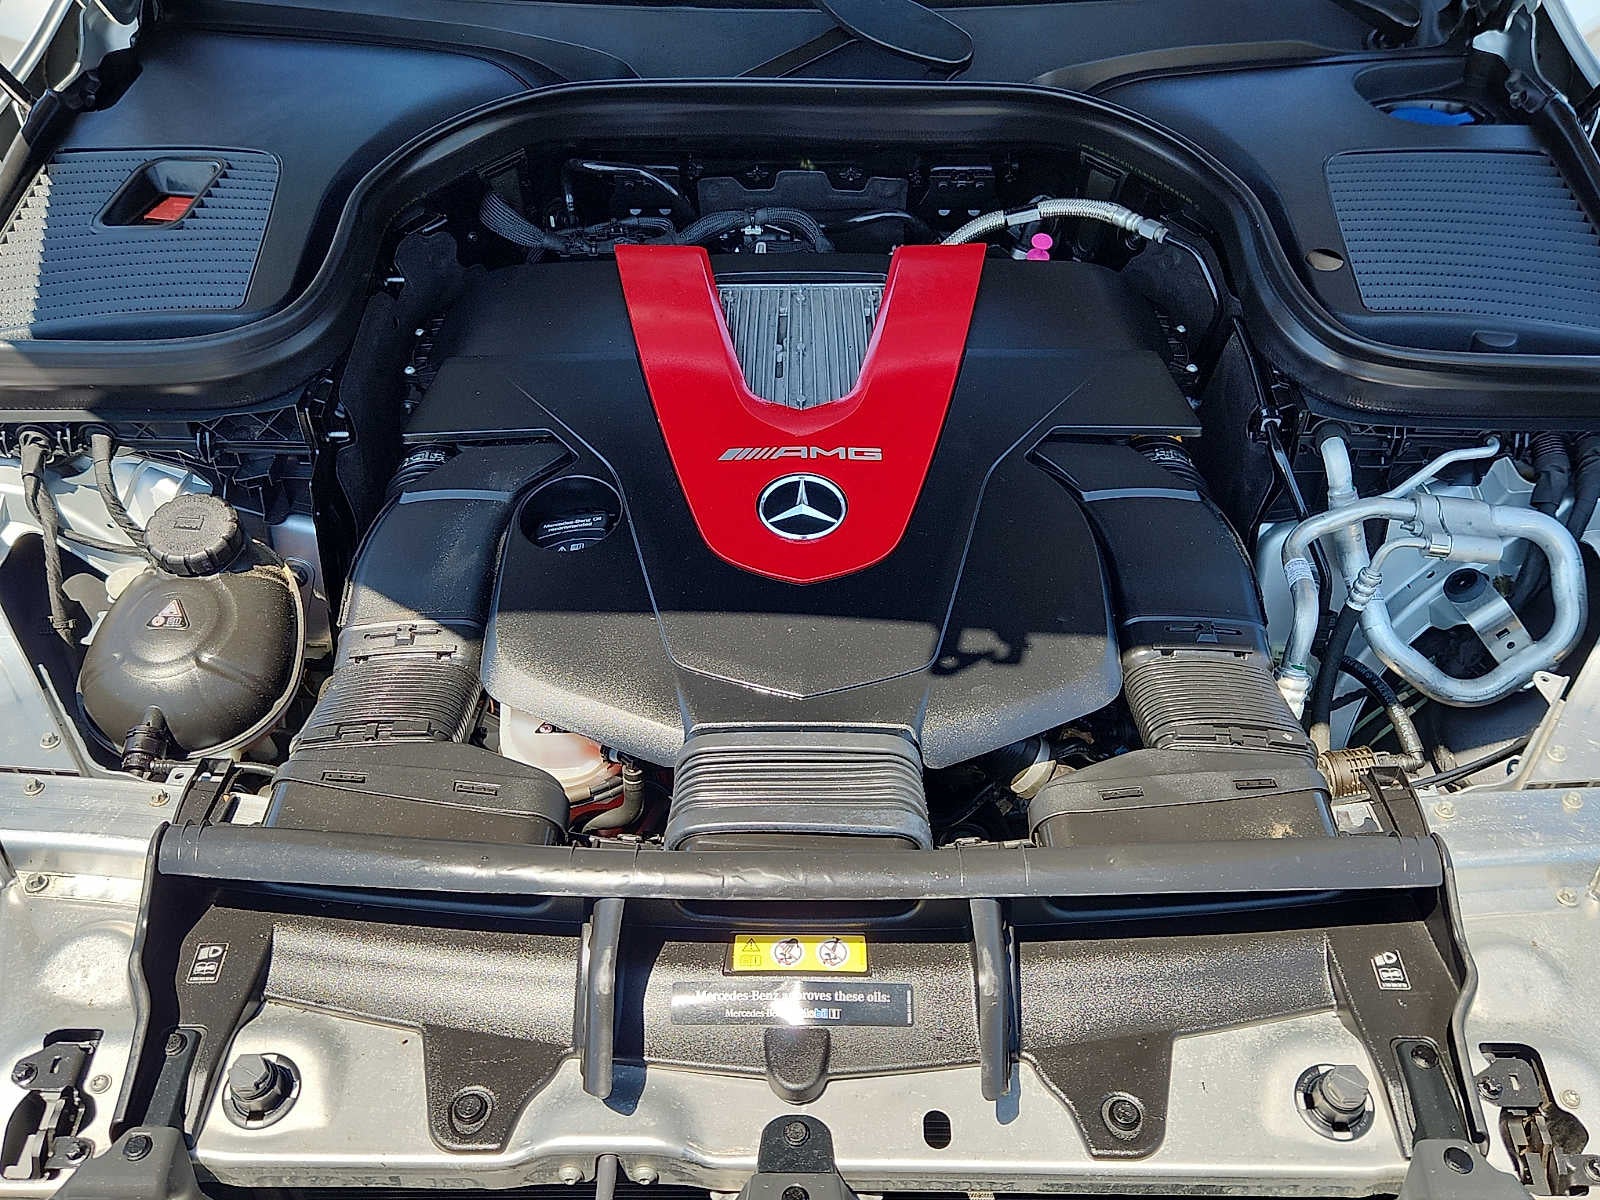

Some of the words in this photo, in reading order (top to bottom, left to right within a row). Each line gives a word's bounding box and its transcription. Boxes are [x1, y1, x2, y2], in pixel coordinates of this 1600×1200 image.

[768, 446, 882, 460] AMG
[543, 517, 592, 529] Mercedes-Benz
[695, 989, 780, 1001] Mercedes-Benz
[834, 990, 865, 1002] these
[866, 990, 891, 1003] oils:
